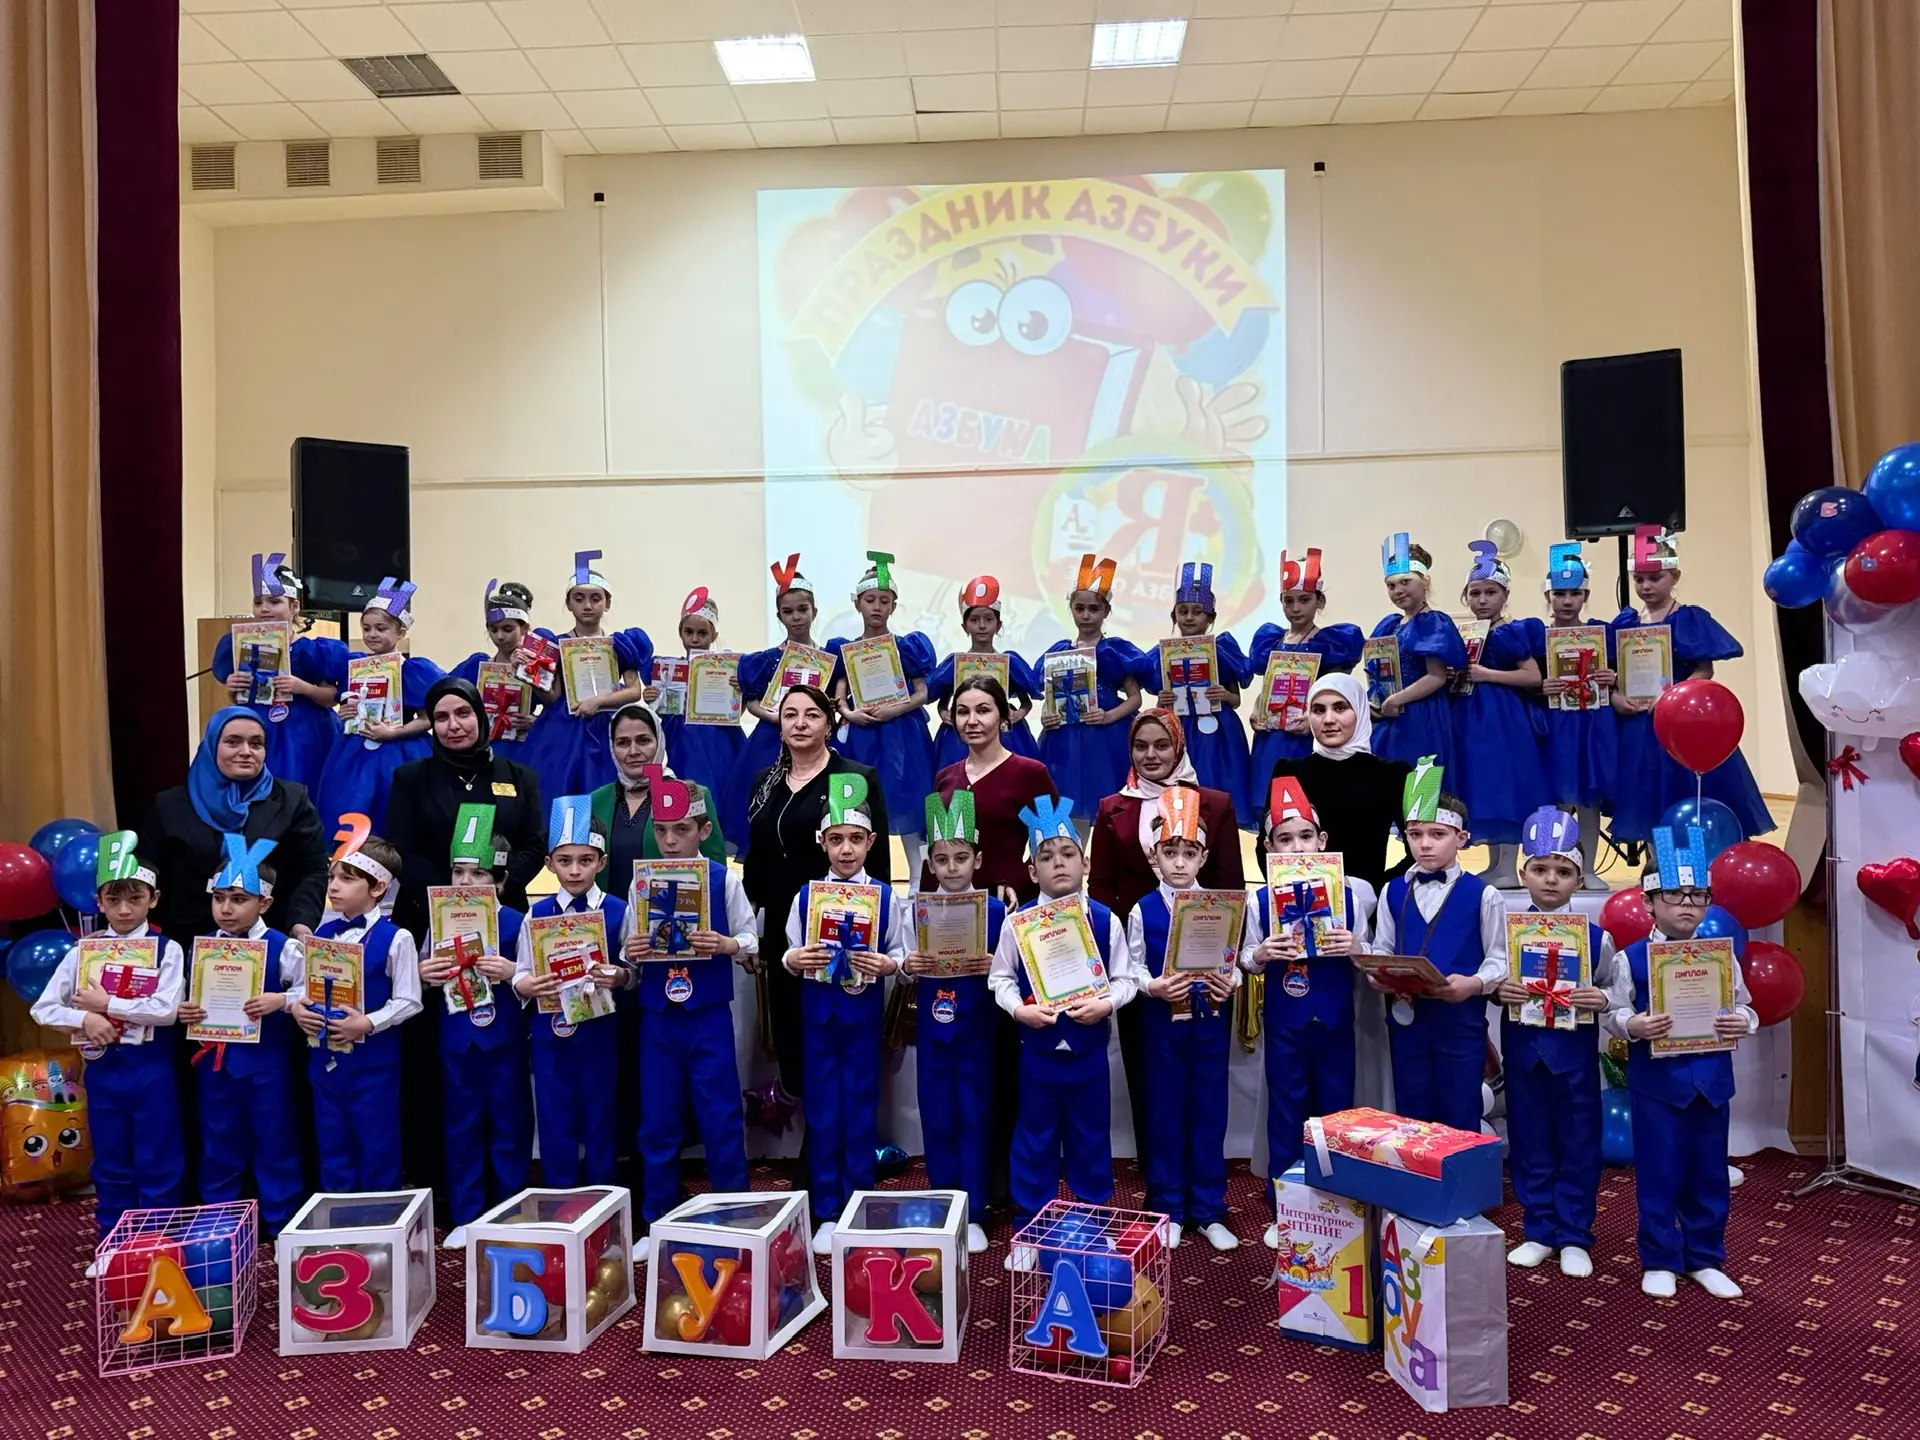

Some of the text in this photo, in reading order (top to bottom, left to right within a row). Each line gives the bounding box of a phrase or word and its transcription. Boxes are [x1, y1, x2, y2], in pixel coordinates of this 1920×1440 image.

[812, 184, 1248, 327] ПРАЗДНИК АЗБУКИ
[906, 399, 1051, 465] АЗБУКА
[1115, 470, 1206, 578] Я
[1634, 524, 1663, 573] Е
[252, 553, 286, 597] К
[575, 550, 602, 585] Г
[770, 553, 800, 596] У
[867, 551, 895, 591] Т
[1077, 554, 1117, 598] И
[1280, 548, 1322, 592] Ы
[1468, 540, 1498, 581] З
[1549, 542, 1585, 590] Б
[377, 576, 417, 617] Ч
[642, 763, 690, 822] Ъ
[828, 772, 869, 826] Р
[1157, 786, 1201, 844] Я
[1270, 775, 1316, 829] А
[1403, 754, 1444, 822] Й
[450, 802, 498, 869] Д
[549, 794, 592, 854] Л
[925, 788, 976, 847] М
[1018, 793, 1084, 859] Ж
[1522, 805, 1579, 858] Ф
[97, 830, 138, 888] В
[214, 832, 280, 896] Х
[1652, 825, 1709, 891] Н
[1674, 968, 1709, 979] ДИПЛОМ
[1287, 1218, 1343, 1240] ЧТЕНИЕ
[119, 1256, 214, 1344] А
[291, 1249, 373, 1333] З
[482, 1246, 548, 1336] Б
[861, 1255, 944, 1345] К
[1023, 1259, 1109, 1359] А
[1341, 1265, 1369, 1319] 1
